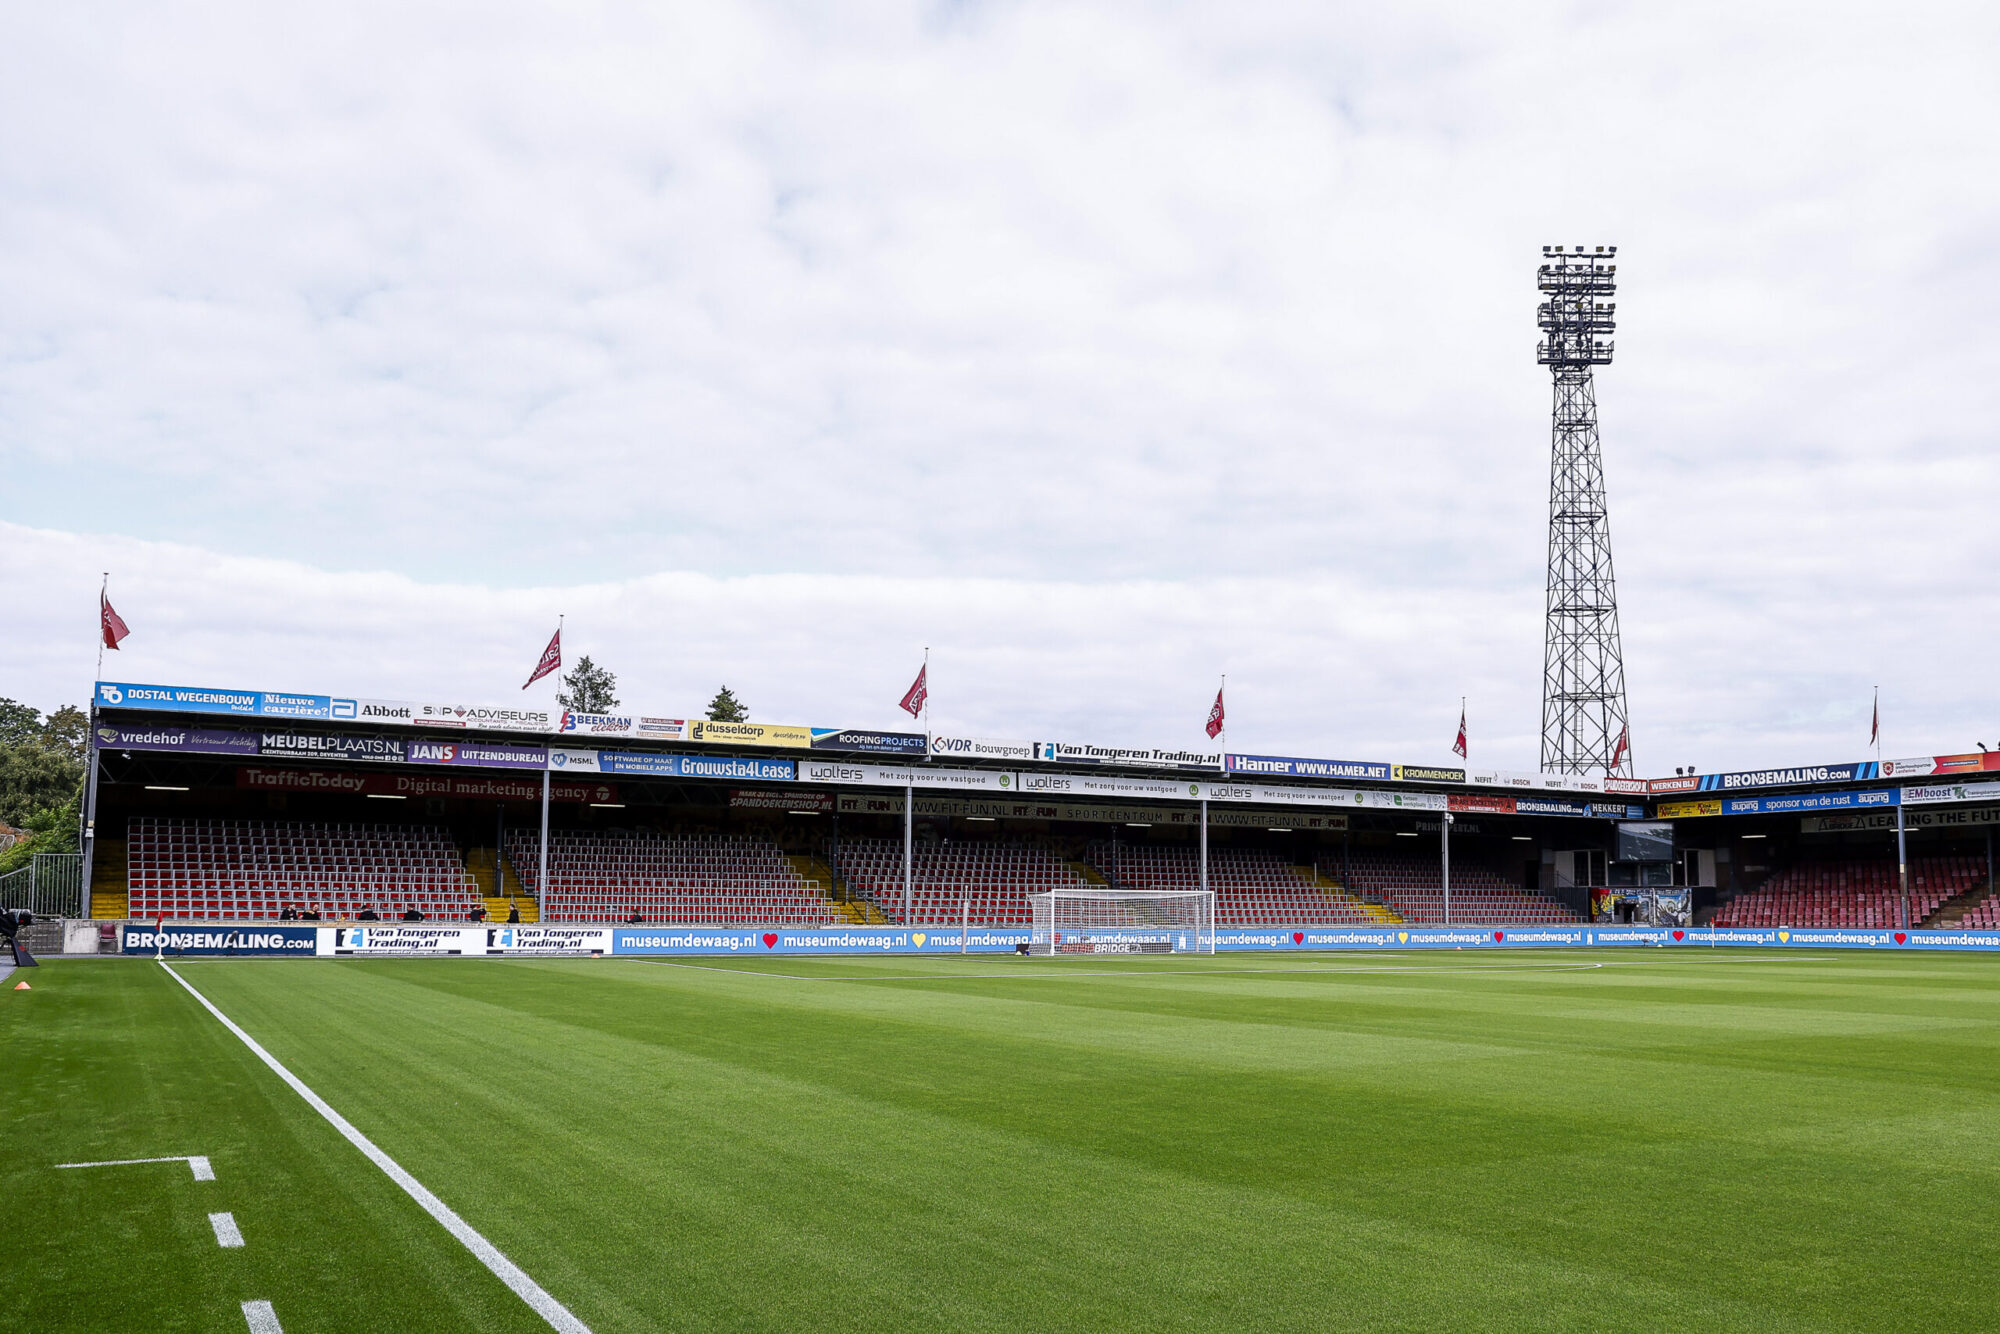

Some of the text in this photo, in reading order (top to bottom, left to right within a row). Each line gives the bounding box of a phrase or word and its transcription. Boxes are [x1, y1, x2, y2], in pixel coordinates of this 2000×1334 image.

[128, 689, 254, 706] DOSTAL WEGENBOUW
[264, 694, 315, 706] Nieuwe
[264, 705, 329, 716] carrière?
[361, 705, 411, 718] Abbott
[423, 706, 548, 722] SNP ADVISEURS
[577, 715, 632, 727] BEEKMAN
[591, 722, 629, 732] elektro
[706, 723, 764, 737] dusseldorp
[121, 732, 186, 745] vredehof
[262, 734, 405, 754] MEUBELPLAATS.NL
[839, 734, 924, 747] ROOFINGPROJECTS
[412, 745, 546, 763] JANS UITZENDBUREAU
[946, 738, 1030, 757] VDR Bouwgroep
[1055, 743, 1221, 765] Van Tongeren Trading.nl
[569, 757, 594, 765] MSML
[603, 755, 673, 765] SOFTWARE OP MAAT
[625, 763, 654, 771] MOBIELE
[681, 757, 791, 778] Grouwsta4Lease
[1235, 756, 1386, 778] Hamer WWW.HAMER.NET
[810, 766, 863, 780] wolters
[879, 771, 895, 779] Met
[897, 773, 914, 782] zorg
[916, 774, 934, 782] voor
[950, 775, 986, 784] vastgoed
[1404, 768, 1464, 781] KROMMENHOEK
[1475, 776, 1493, 784] NEFIT
[247, 770, 589, 801] TrafficToday Digital marketing agency
[1026, 777, 1071, 789] wolters
[1099, 783, 1115, 791] zorg
[1146, 785, 1177, 793] vastgoed
[1512, 778, 1530, 786] BOSCH
[1651, 779, 1695, 790] WERKEN BIJ
[784, 792, 815, 800] SPANDOEK
[1210, 786, 1251, 798] wolters
[729, 797, 832, 810] SPANDOEKENSHOP.NL
[1592, 803, 1626, 813] HEKKERT
[1731, 792, 1889, 811] auping sponsor van de rust auping
[1036, 806, 1057, 817] FUN
[1067, 809, 1163, 822] SPORTCENTRUM
[1214, 814, 1306, 827] WWW.FIT-FUN.NL
[1869, 813, 1932, 828] LEAING
[1936, 811, 1967, 824] THE
[1416, 821, 1480, 833] PRINTPERT.NL
[367, 928, 461, 940] Van Tongeren
[516, 928, 603, 941] Van Tongeren
[621, 933, 757, 950] museumdewaag.nl
[784, 932, 907, 950] museumdewaag.nl
[1307, 932, 1395, 946] museumdewaag.nl
[1411, 932, 1491, 945] museumdewaag.nl
[1507, 931, 1581, 944] museumdewaag.nl
[1598, 930, 1668, 942] museumdewaag.nl
[1688, 931, 1776, 944] museumdewaag.nl
[1792, 932, 1890, 946] museumdewaag.nl
[1911, 933, 2000, 946] museumdewaa
[367, 938, 438, 949] Trading.nl
[516, 938, 582, 949] Trading.nl
[1095, 943, 1131, 953] BRIDGE
